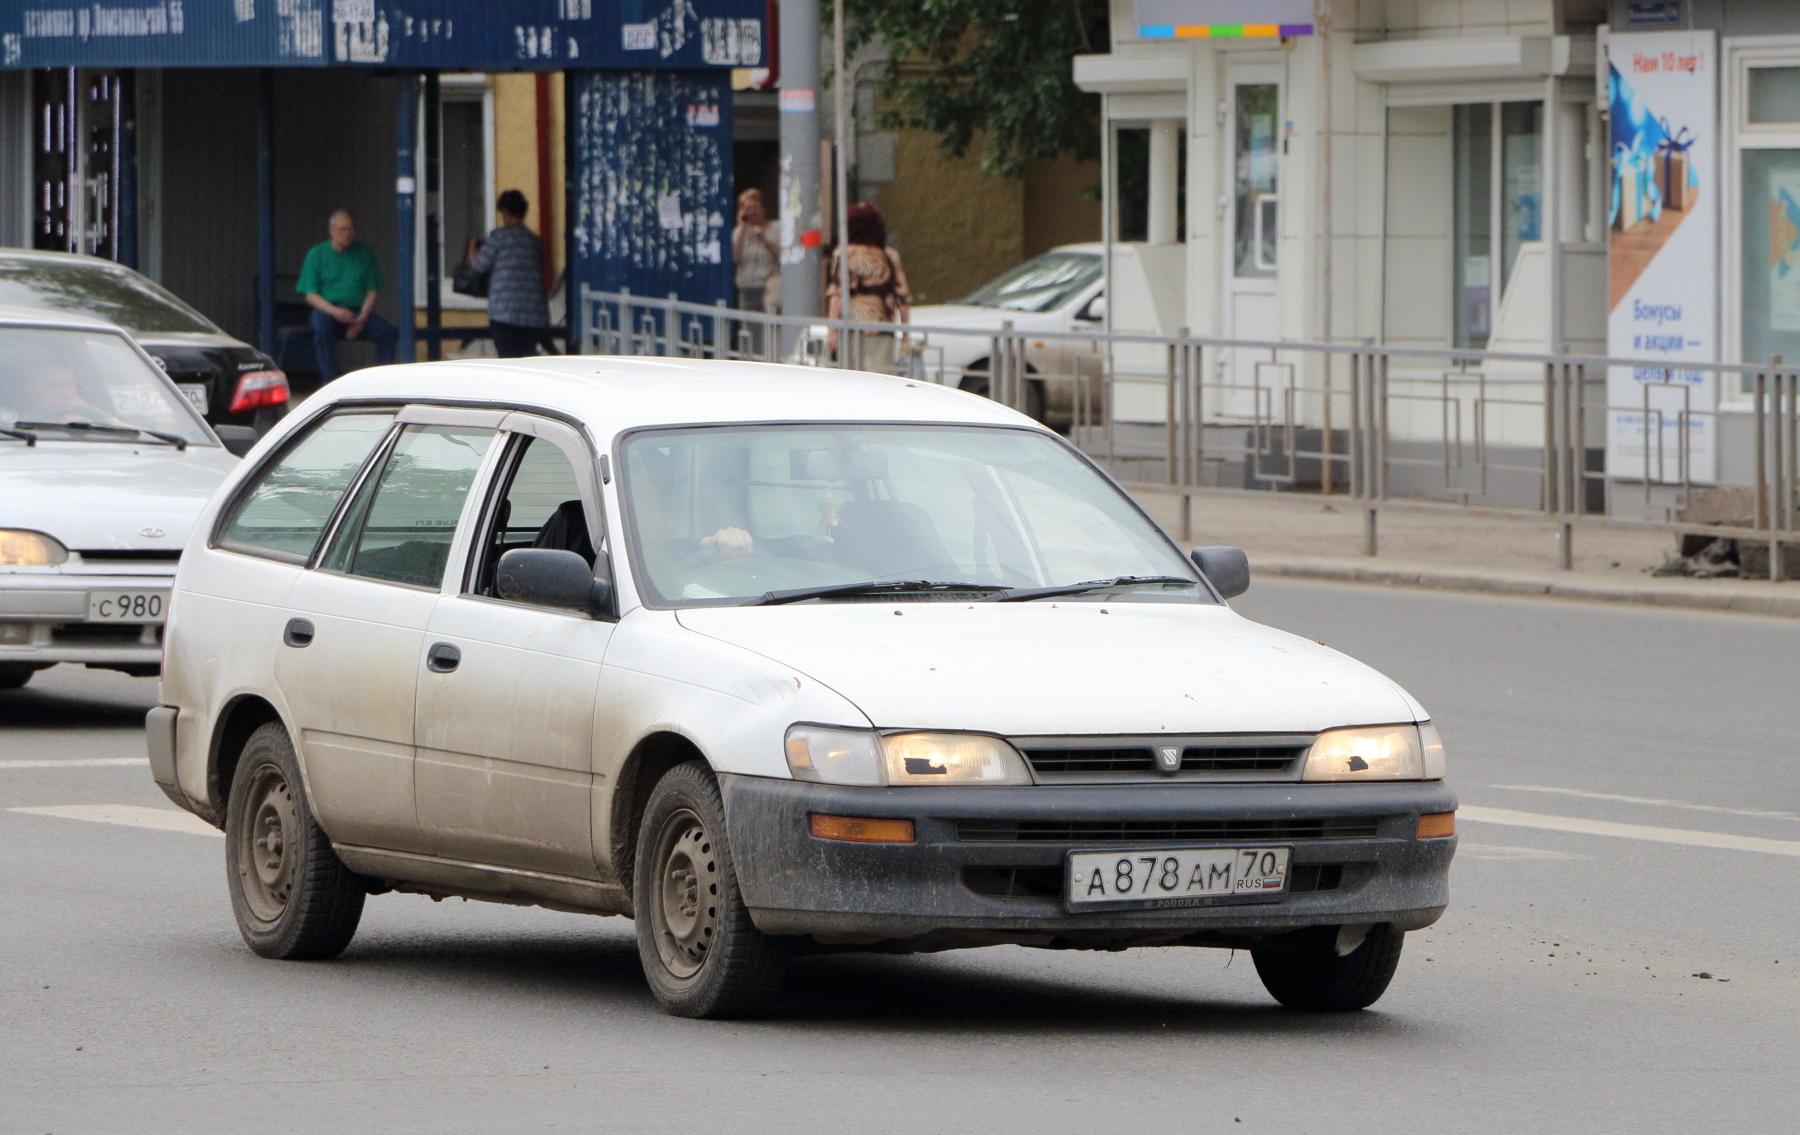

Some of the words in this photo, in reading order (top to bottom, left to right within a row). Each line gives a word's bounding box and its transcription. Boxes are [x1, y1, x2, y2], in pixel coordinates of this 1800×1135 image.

[1634, 298, 1682, 327] Бонусы
[1645, 335, 1684, 354] акции
[1087, 856, 1232, 896] А878АМ
[1242, 851, 1276, 878] 70
[1236, 878, 1262, 890] RUS
